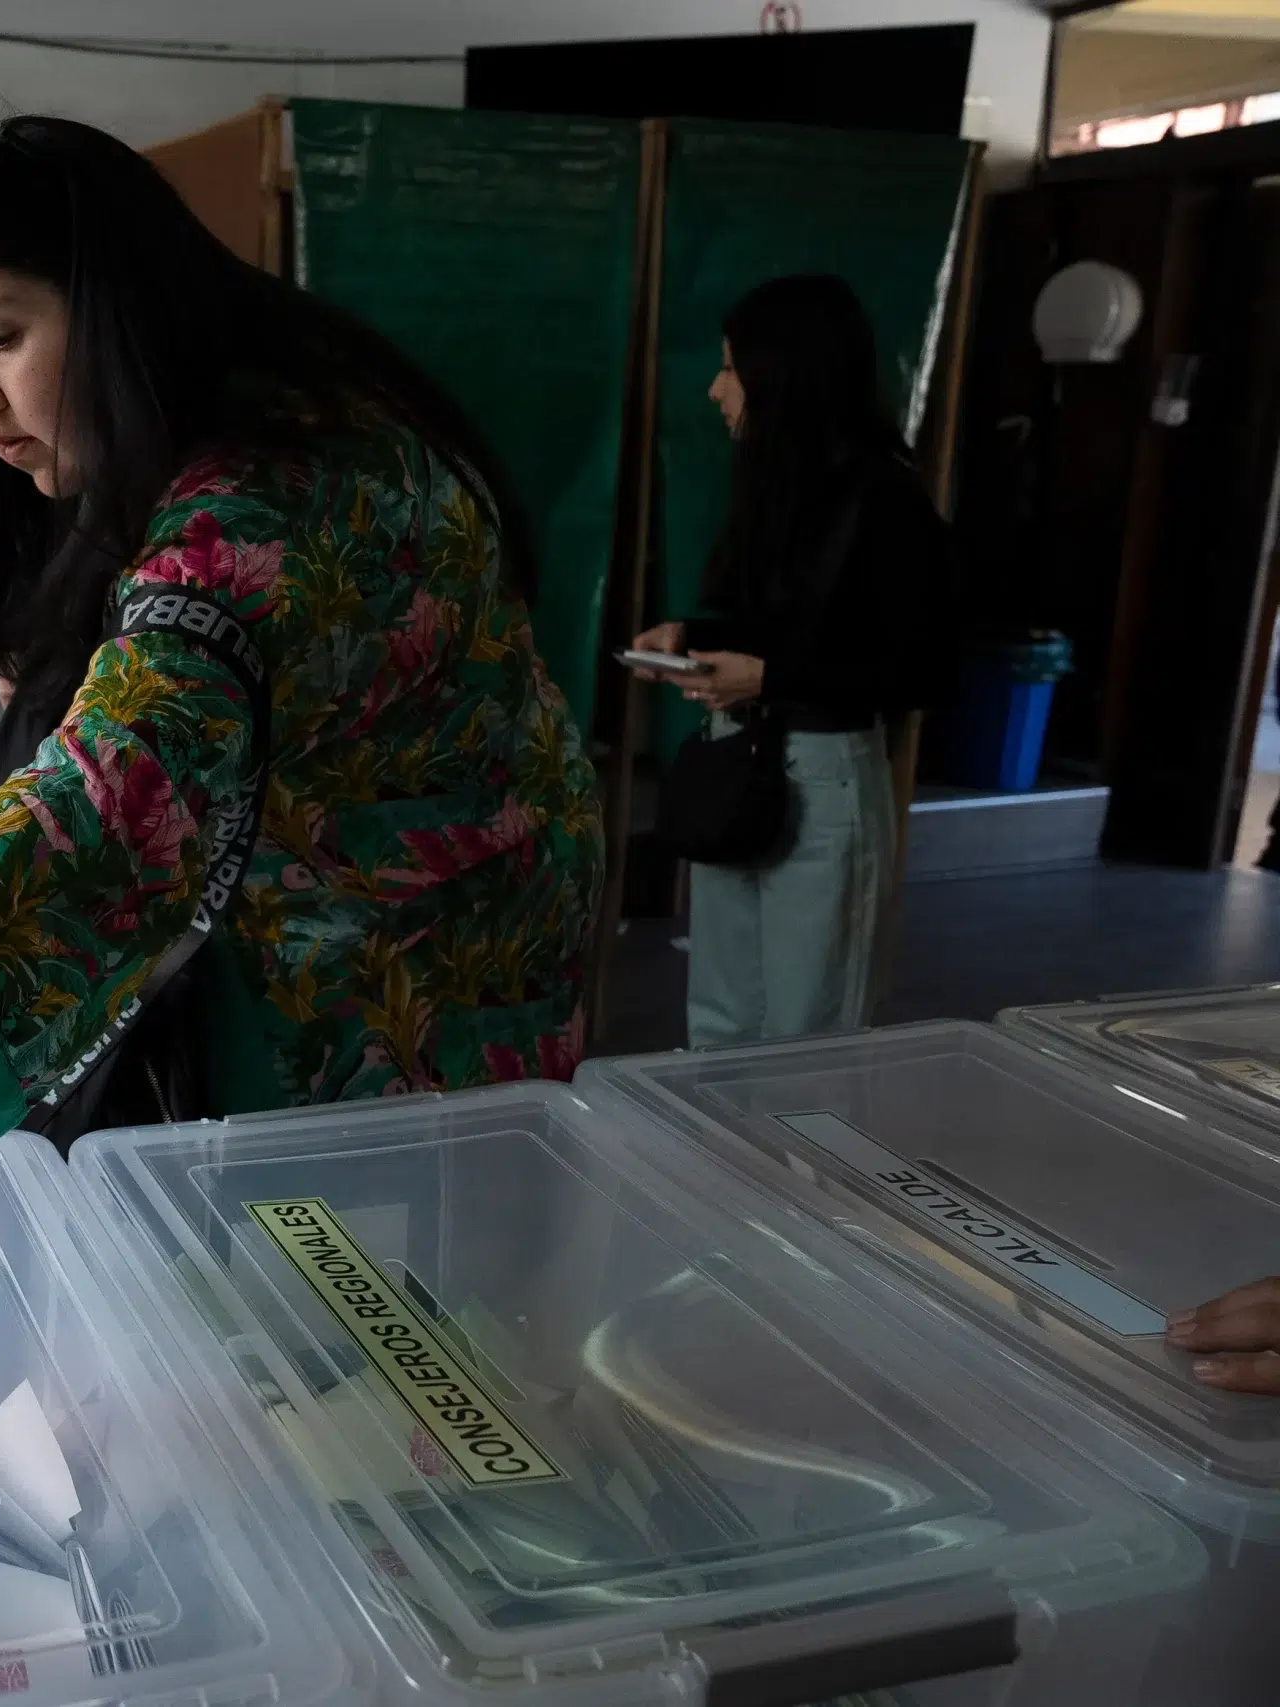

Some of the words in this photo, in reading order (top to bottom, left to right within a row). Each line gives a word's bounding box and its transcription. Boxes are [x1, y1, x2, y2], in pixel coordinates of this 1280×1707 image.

[272, 1204, 398, 1319] REGIONALES
[876, 1168, 1061, 1267] ALCALDE
[369, 1323, 531, 1475] CONSEJEROS
